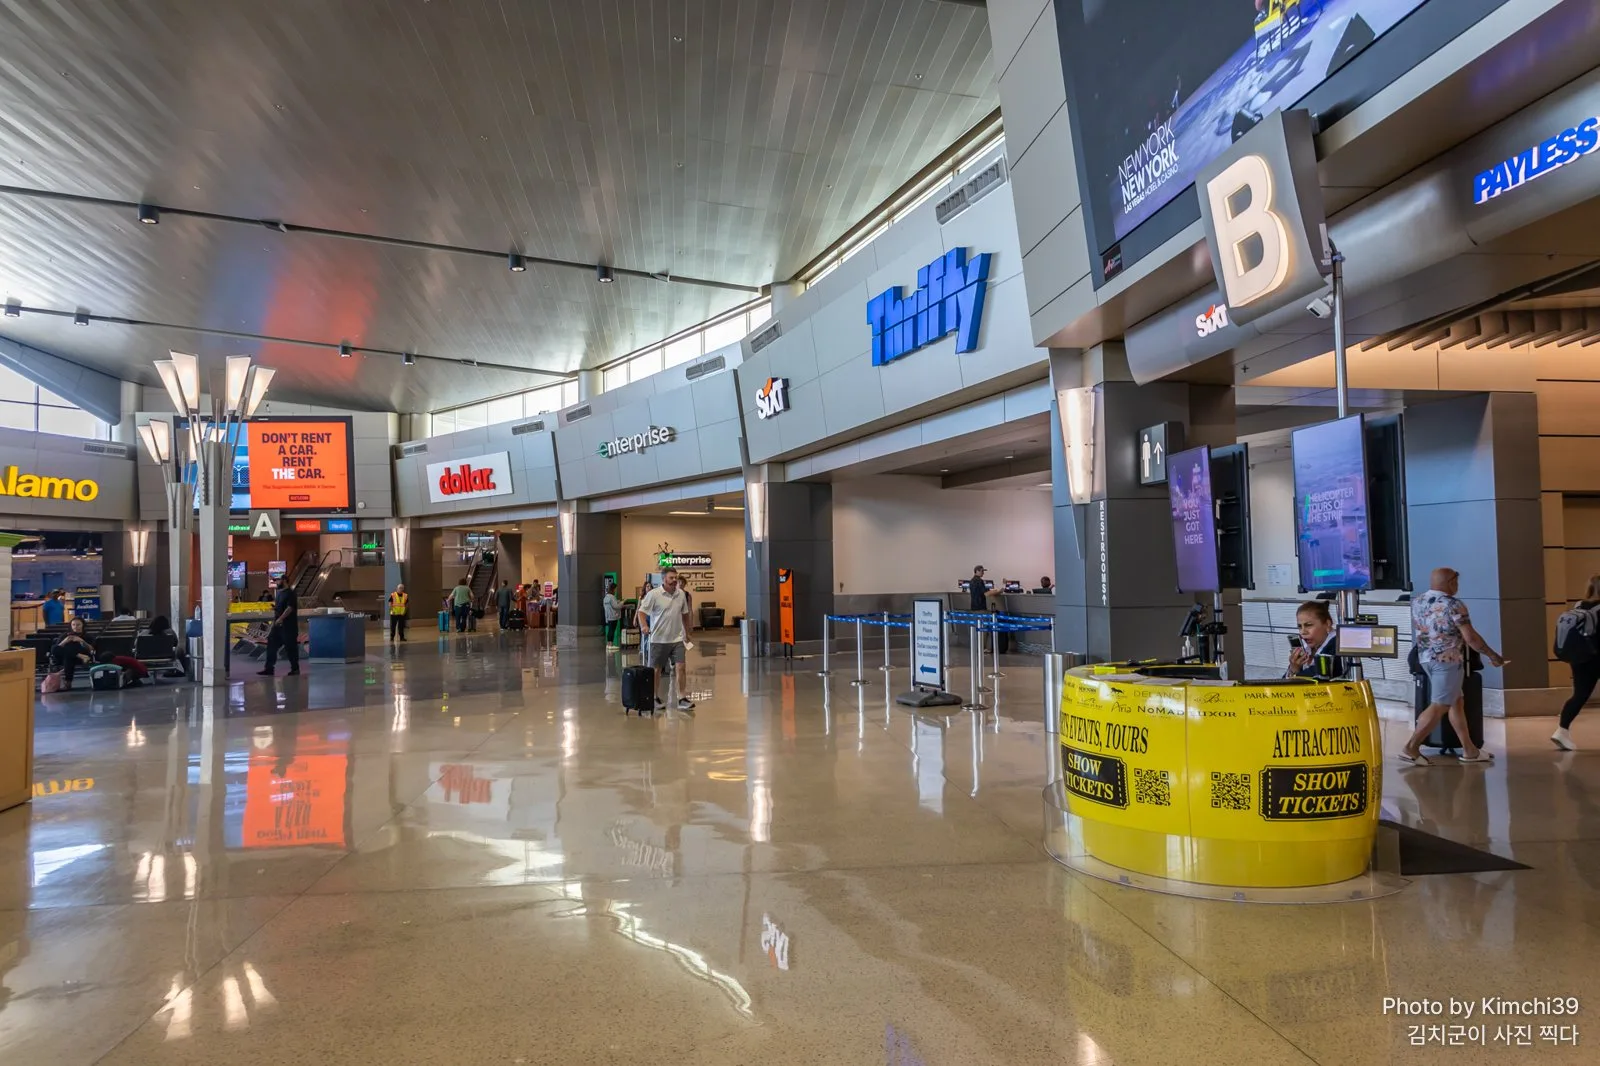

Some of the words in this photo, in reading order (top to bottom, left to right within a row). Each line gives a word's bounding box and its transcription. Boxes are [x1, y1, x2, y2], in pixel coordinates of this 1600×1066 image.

[1118, 145, 1142, 184] NEW
[1142, 116, 1174, 160] YORK
[1473, 116, 1600, 204] PAYLESS
[1122, 166, 1144, 204] NEW
[1146, 139, 1178, 183] YORK
[1124, 202, 1132, 214] LAS
[1132, 191, 1144, 208] VEGAS
[1145, 182, 1158, 197] HOTEL
[1162, 164, 1178, 184] CASINO
[1207, 155, 1289, 308] B
[867, 247, 992, 367] Thrifty
[262, 433, 298, 444] DON'T
[301, 433, 332, 444] RENT
[595, 425, 674, 458] enterprise
[278, 445, 286, 455] A
[289, 445, 317, 455] CAR.
[282, 457, 313, 467] RENT
[272, 468, 296, 480] THE
[298, 468, 325, 479] CAR.
[1184, 498, 1200, 509] YOU
[1309, 487, 1354, 502] HELICOPTER
[1309, 500, 1333, 512] TOURS
[1334, 499, 1344, 510] OF
[252, 512, 277, 537] A
[1184, 510, 1200, 521] JUST
[1324, 510, 1342, 521] STRIP
[1186, 522, 1200, 532] GOT
[1184, 534, 1204, 544] HERE
[664, 556, 712, 565] enterprise
[1111, 702, 1132, 713] Aria
[1248, 706, 1297, 716] Excalibur
[1070, 714, 1102, 752] EVENTS,
[1106, 722, 1148, 754] TOURS
[1272, 725, 1360, 758] ATTRACTIONS
[1068, 752, 1102, 776] SHOW
[1066, 770, 1114, 800] TICKETS
[1293, 770, 1350, 791] SHOW
[1278, 792, 1360, 814] TICKETS
